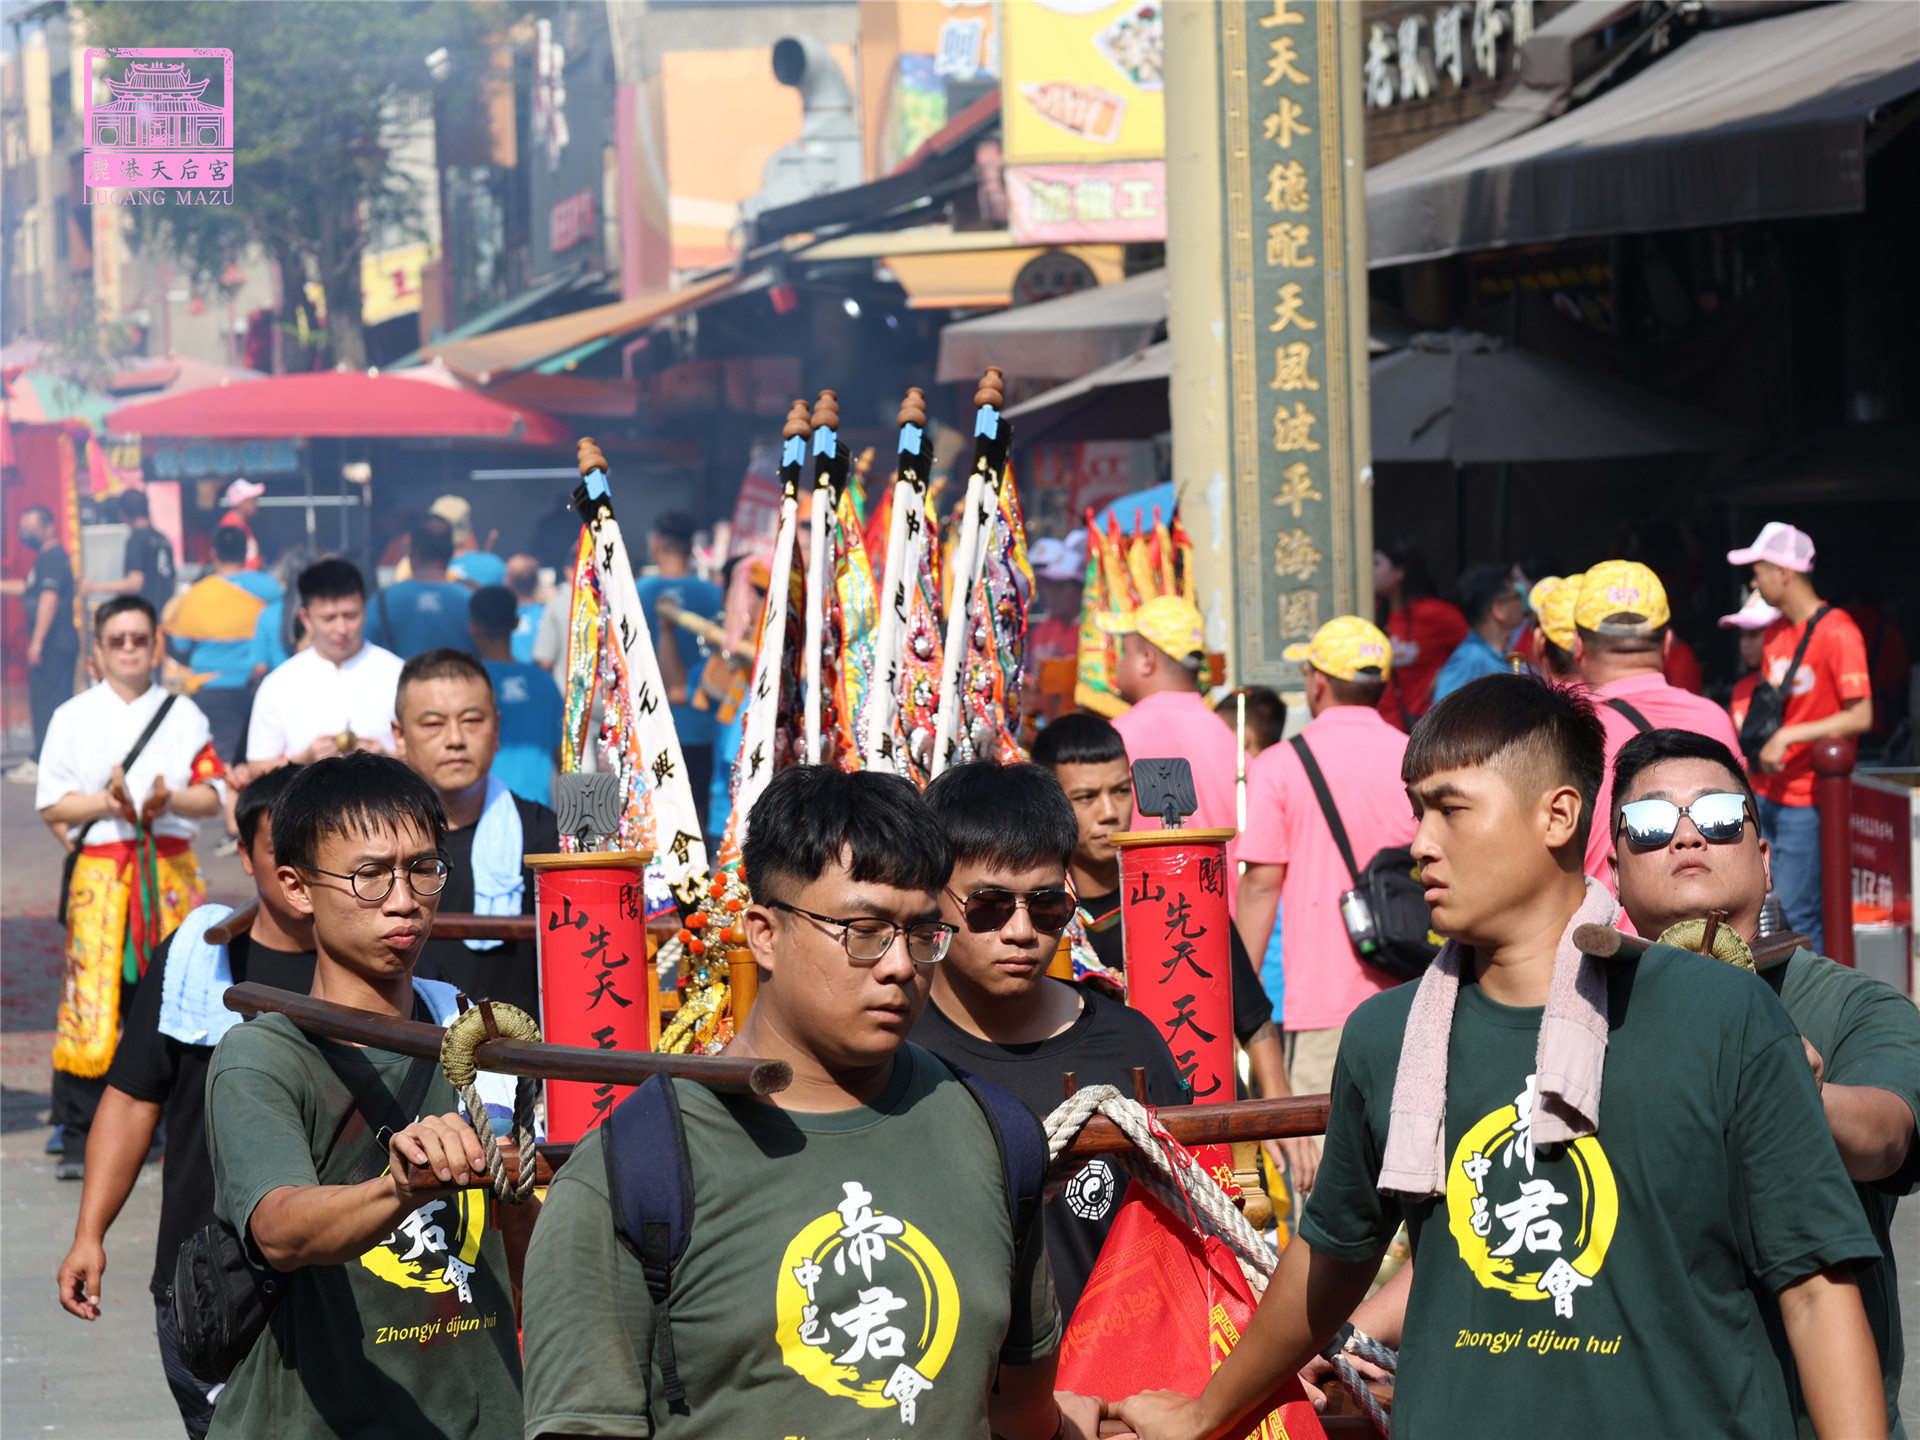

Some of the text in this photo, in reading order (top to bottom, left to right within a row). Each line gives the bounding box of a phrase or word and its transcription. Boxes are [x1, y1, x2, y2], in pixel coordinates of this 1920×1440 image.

[1461, 1151, 1493, 1238] 中邑
[375, 1312, 497, 1345] Zhongyi dijun hui
[791, 1257, 831, 1346] 中邑
[831, 1181, 934, 1426] 帝君會
[1455, 1328, 1622, 1356] Zhongyi dijun hui
